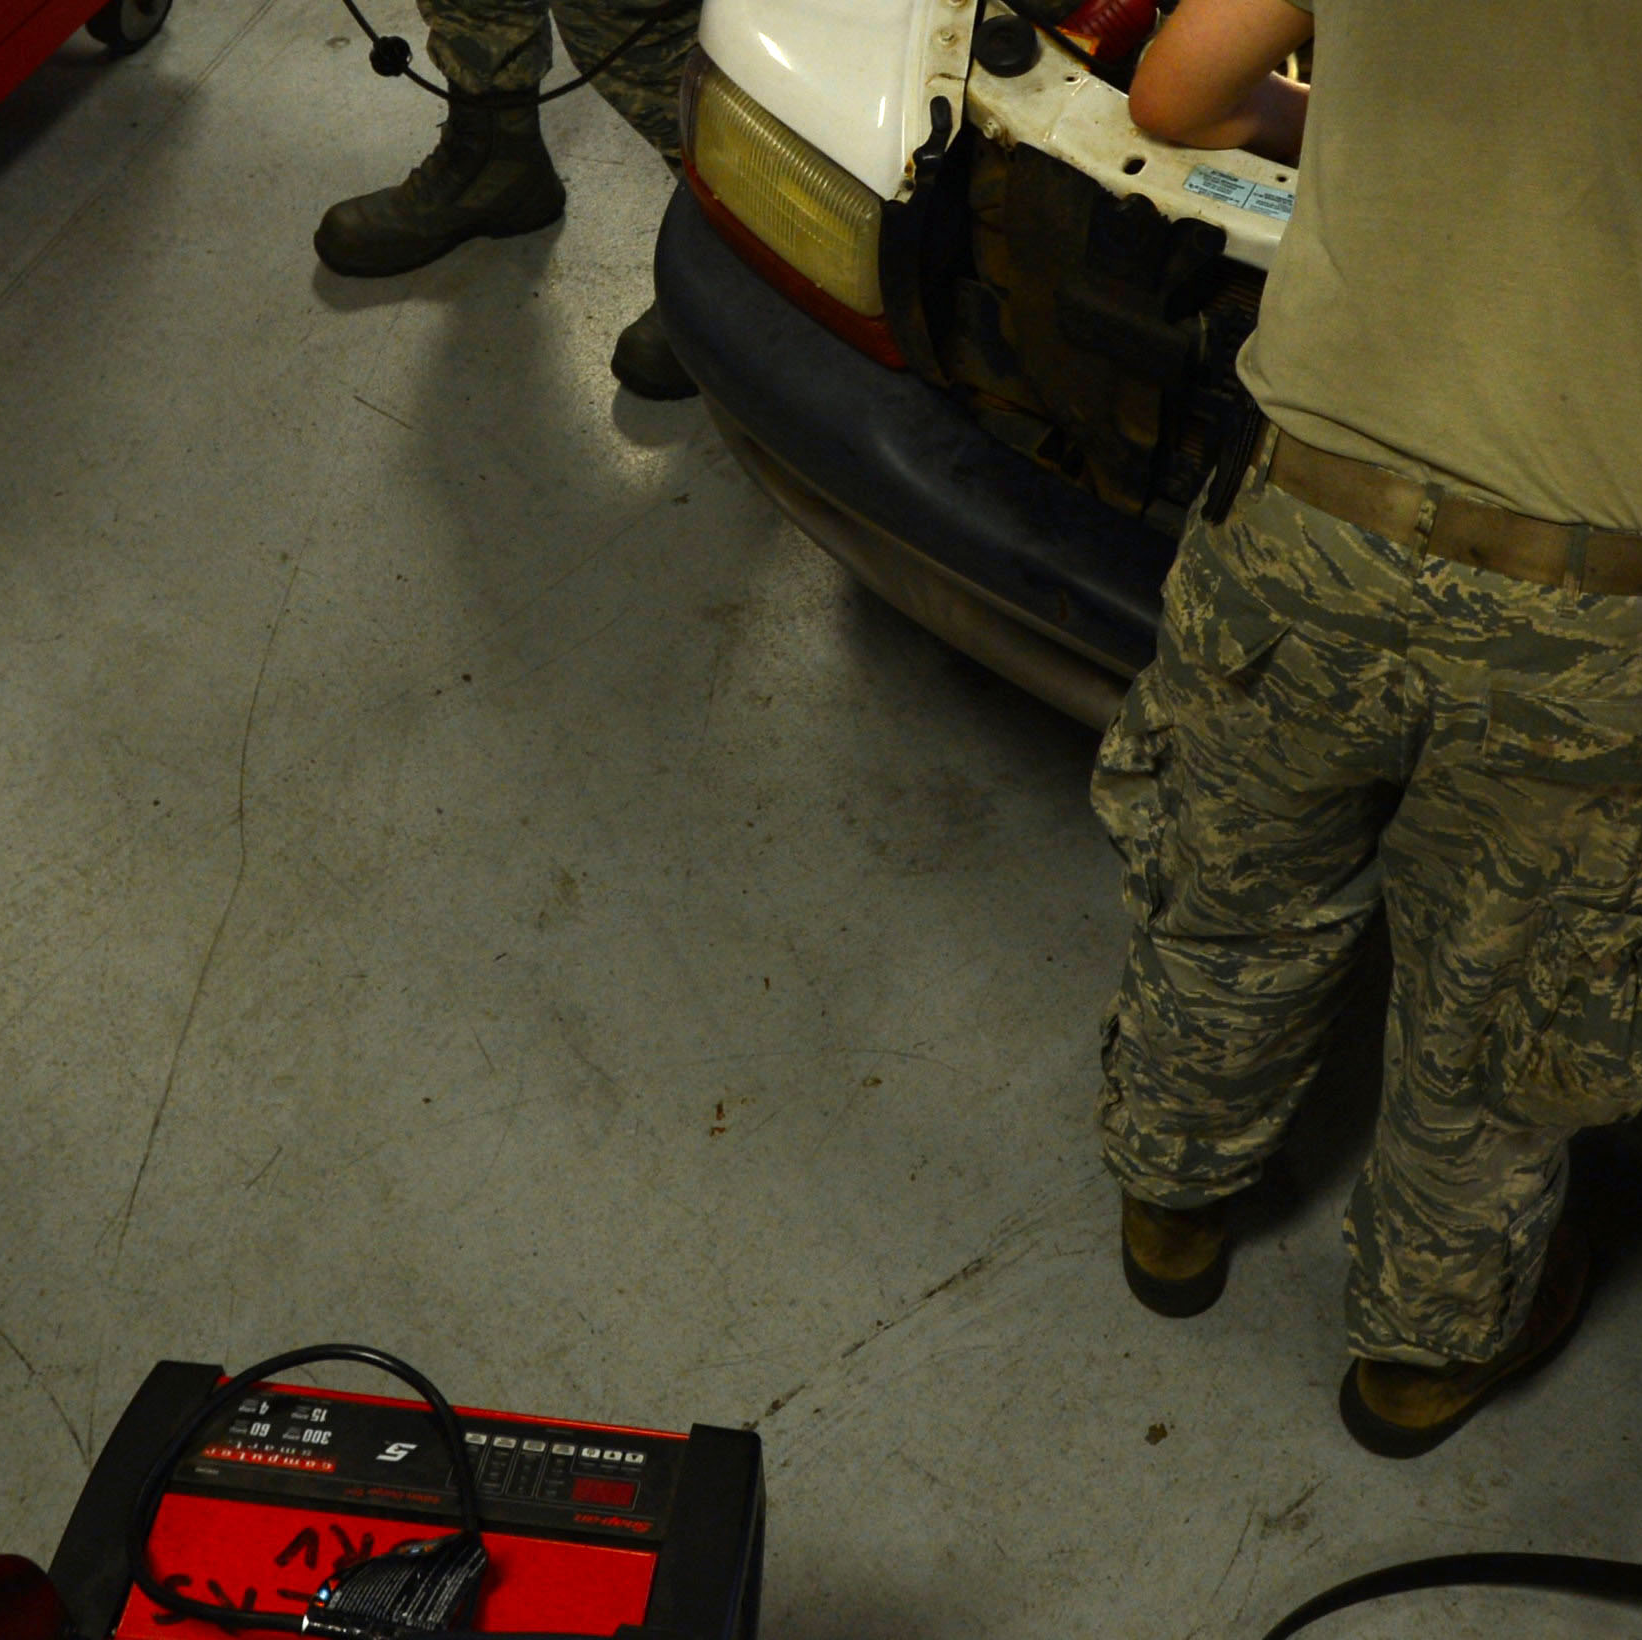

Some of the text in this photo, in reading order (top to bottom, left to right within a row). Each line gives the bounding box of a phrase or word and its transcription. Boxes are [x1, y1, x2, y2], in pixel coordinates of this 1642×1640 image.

[310, 1407, 328, 1423] 15
[249, 1422, 270, 1438] 60
[302, 1429, 332, 1445] 300
[204, 1447, 335, 1472] computer
